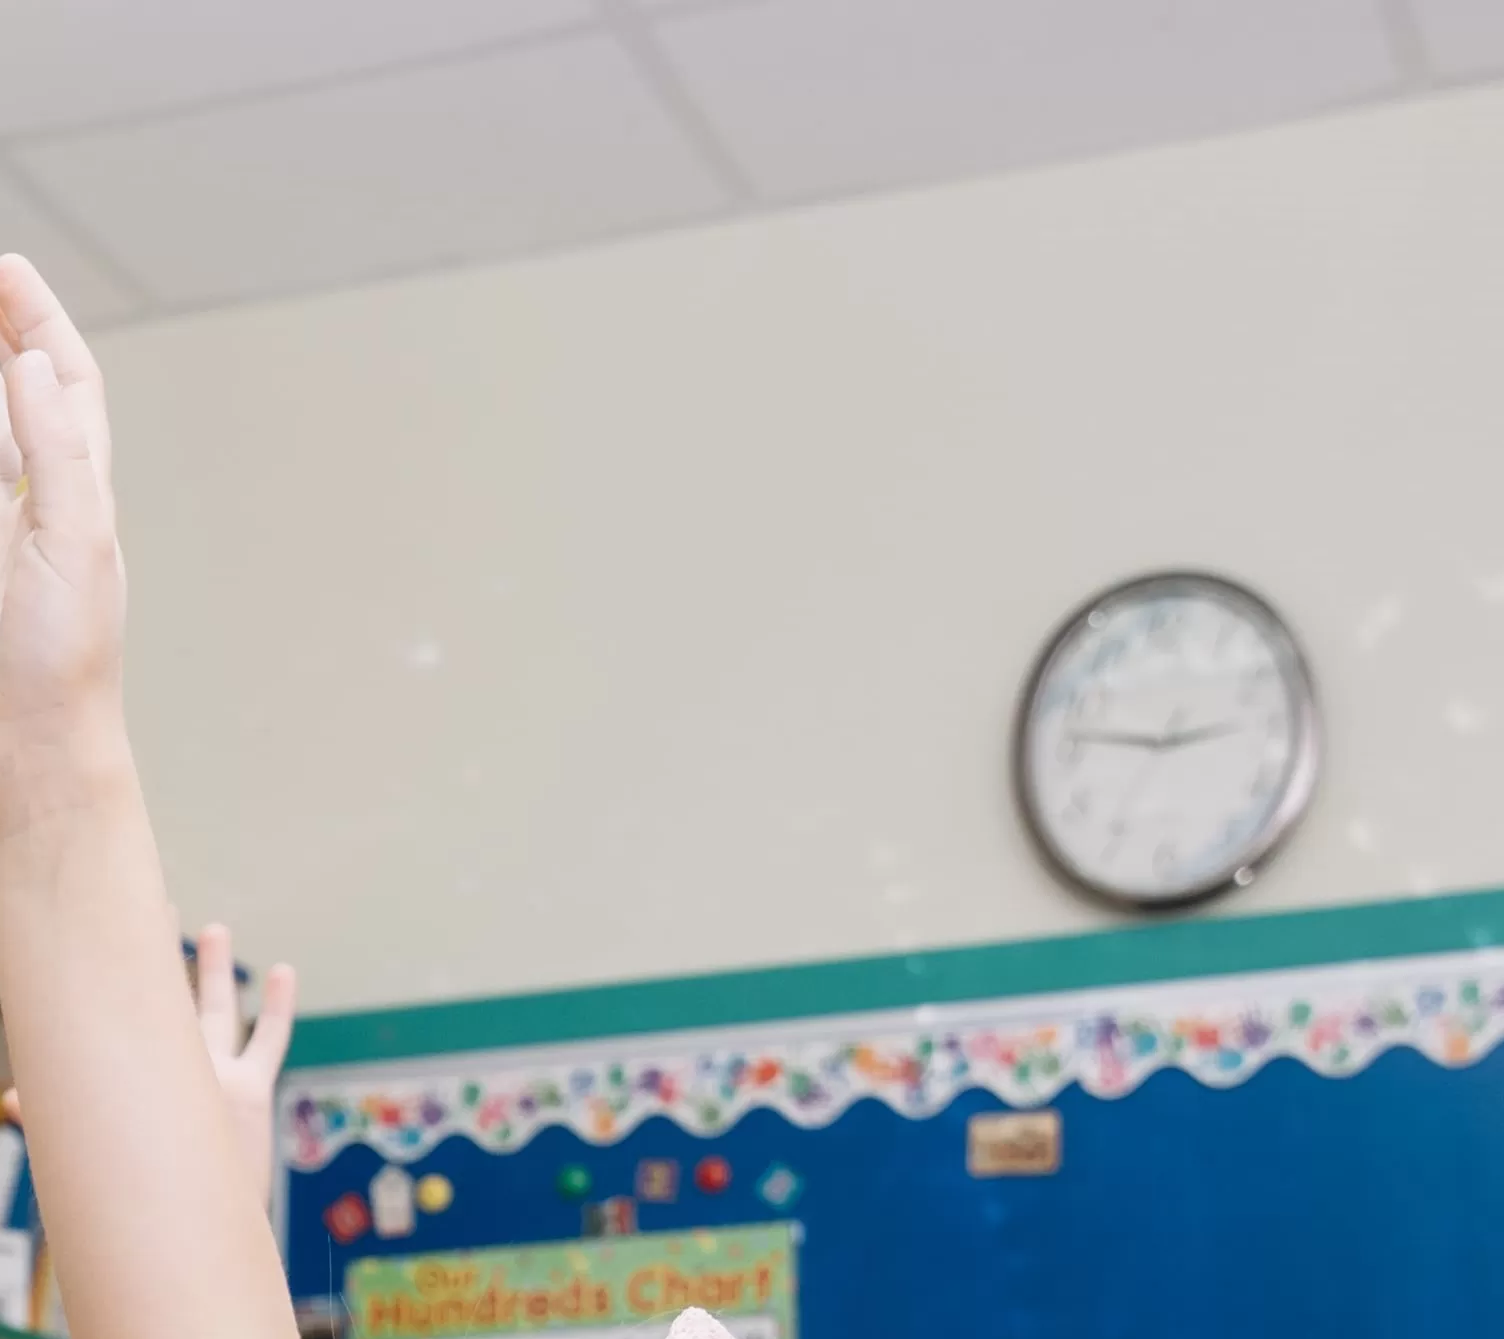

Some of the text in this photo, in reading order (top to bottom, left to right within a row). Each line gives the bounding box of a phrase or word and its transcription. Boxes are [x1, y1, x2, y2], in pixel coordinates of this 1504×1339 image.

[365, 1262, 776, 1337] Hundreds Chart
[414, 1260, 478, 1295] Our
